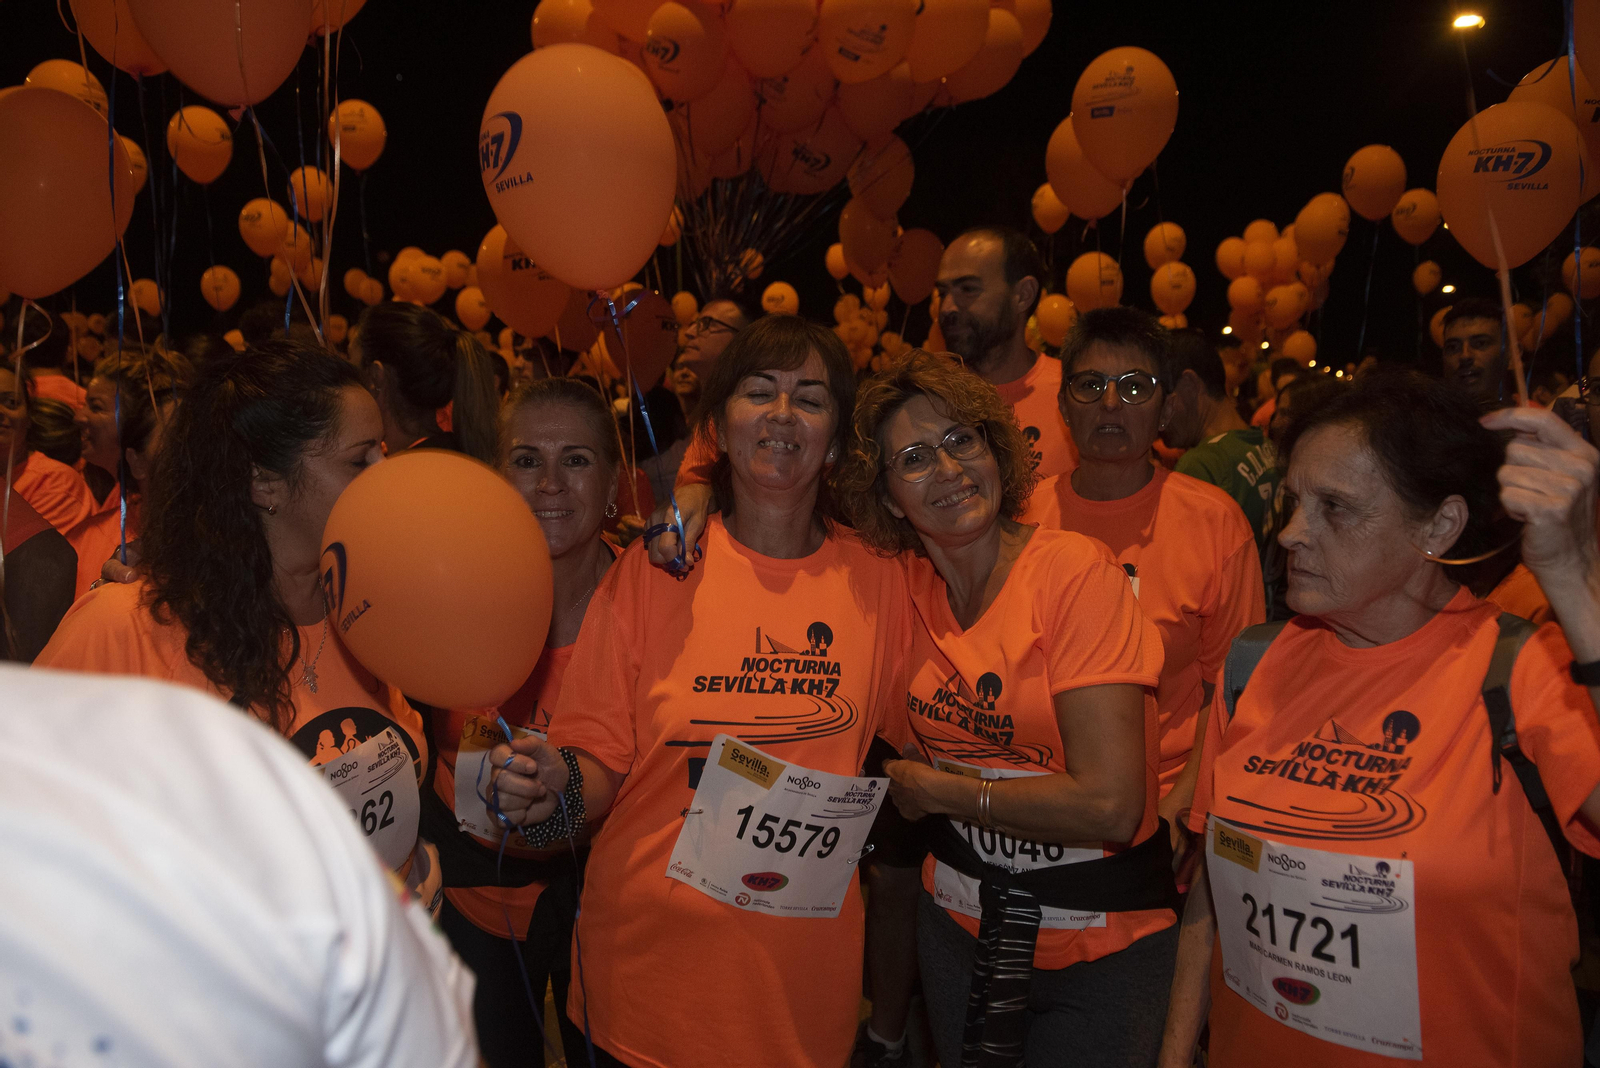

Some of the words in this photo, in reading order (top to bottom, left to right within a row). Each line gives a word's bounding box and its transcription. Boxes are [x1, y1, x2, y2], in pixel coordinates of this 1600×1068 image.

[1468, 147, 1516, 155] NOCTURNA
[496, 172, 533, 193] SEVILLA
[741, 657, 841, 676] NOCTURNA
[692, 676, 786, 694] SEVILLA
[367, 755, 390, 773] SEVILLA
[1291, 742, 1412, 773] NOCTURNA
[1244, 755, 1338, 790] SEVILLA
[827, 796, 855, 804] SEVILLA
[736, 804, 841, 859] 15579
[1321, 879, 1366, 893] SEVILLA
[1344, 874, 1395, 888] NOCTURNA
[1242, 893, 1360, 969] 21721
[1263, 950, 1293, 968] CARMEN
[1295, 962, 1325, 978] RAMOS
[1327, 972, 1352, 984] LEON
